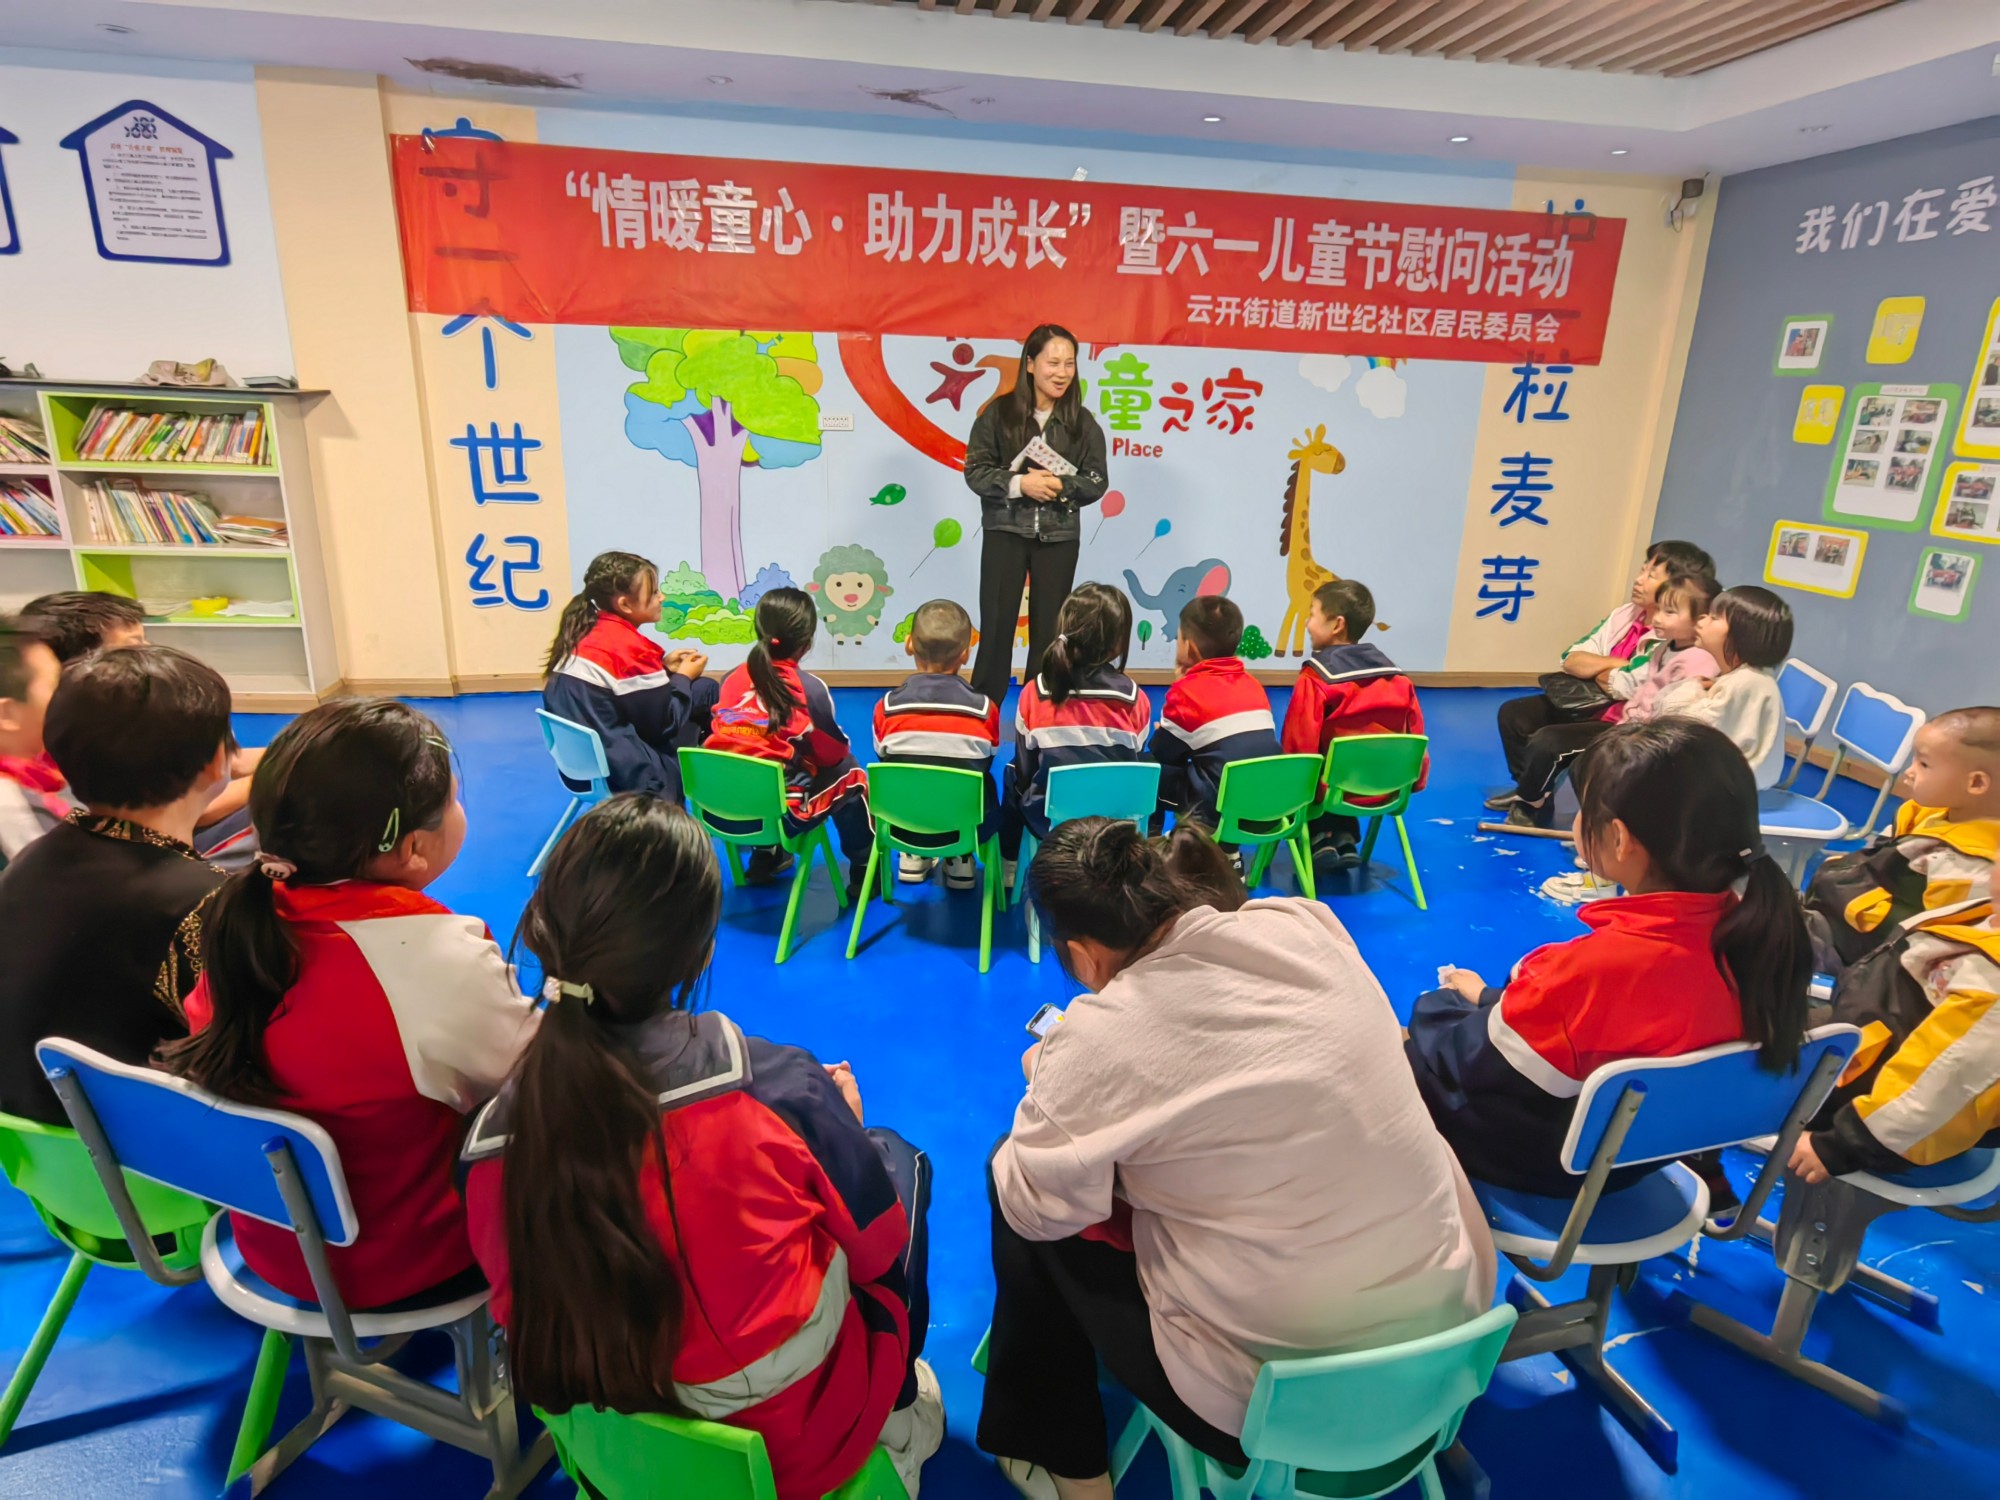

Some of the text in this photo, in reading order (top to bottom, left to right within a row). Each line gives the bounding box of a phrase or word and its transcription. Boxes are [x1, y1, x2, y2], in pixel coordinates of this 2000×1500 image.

[1795, 175, 1998, 254] 我们在爱
[1186, 293, 1561, 343] 云开街道新世纪社区居民委员会
[1080, 352, 1263, 435] 童之家
[1112, 437, 1163, 458] Place
